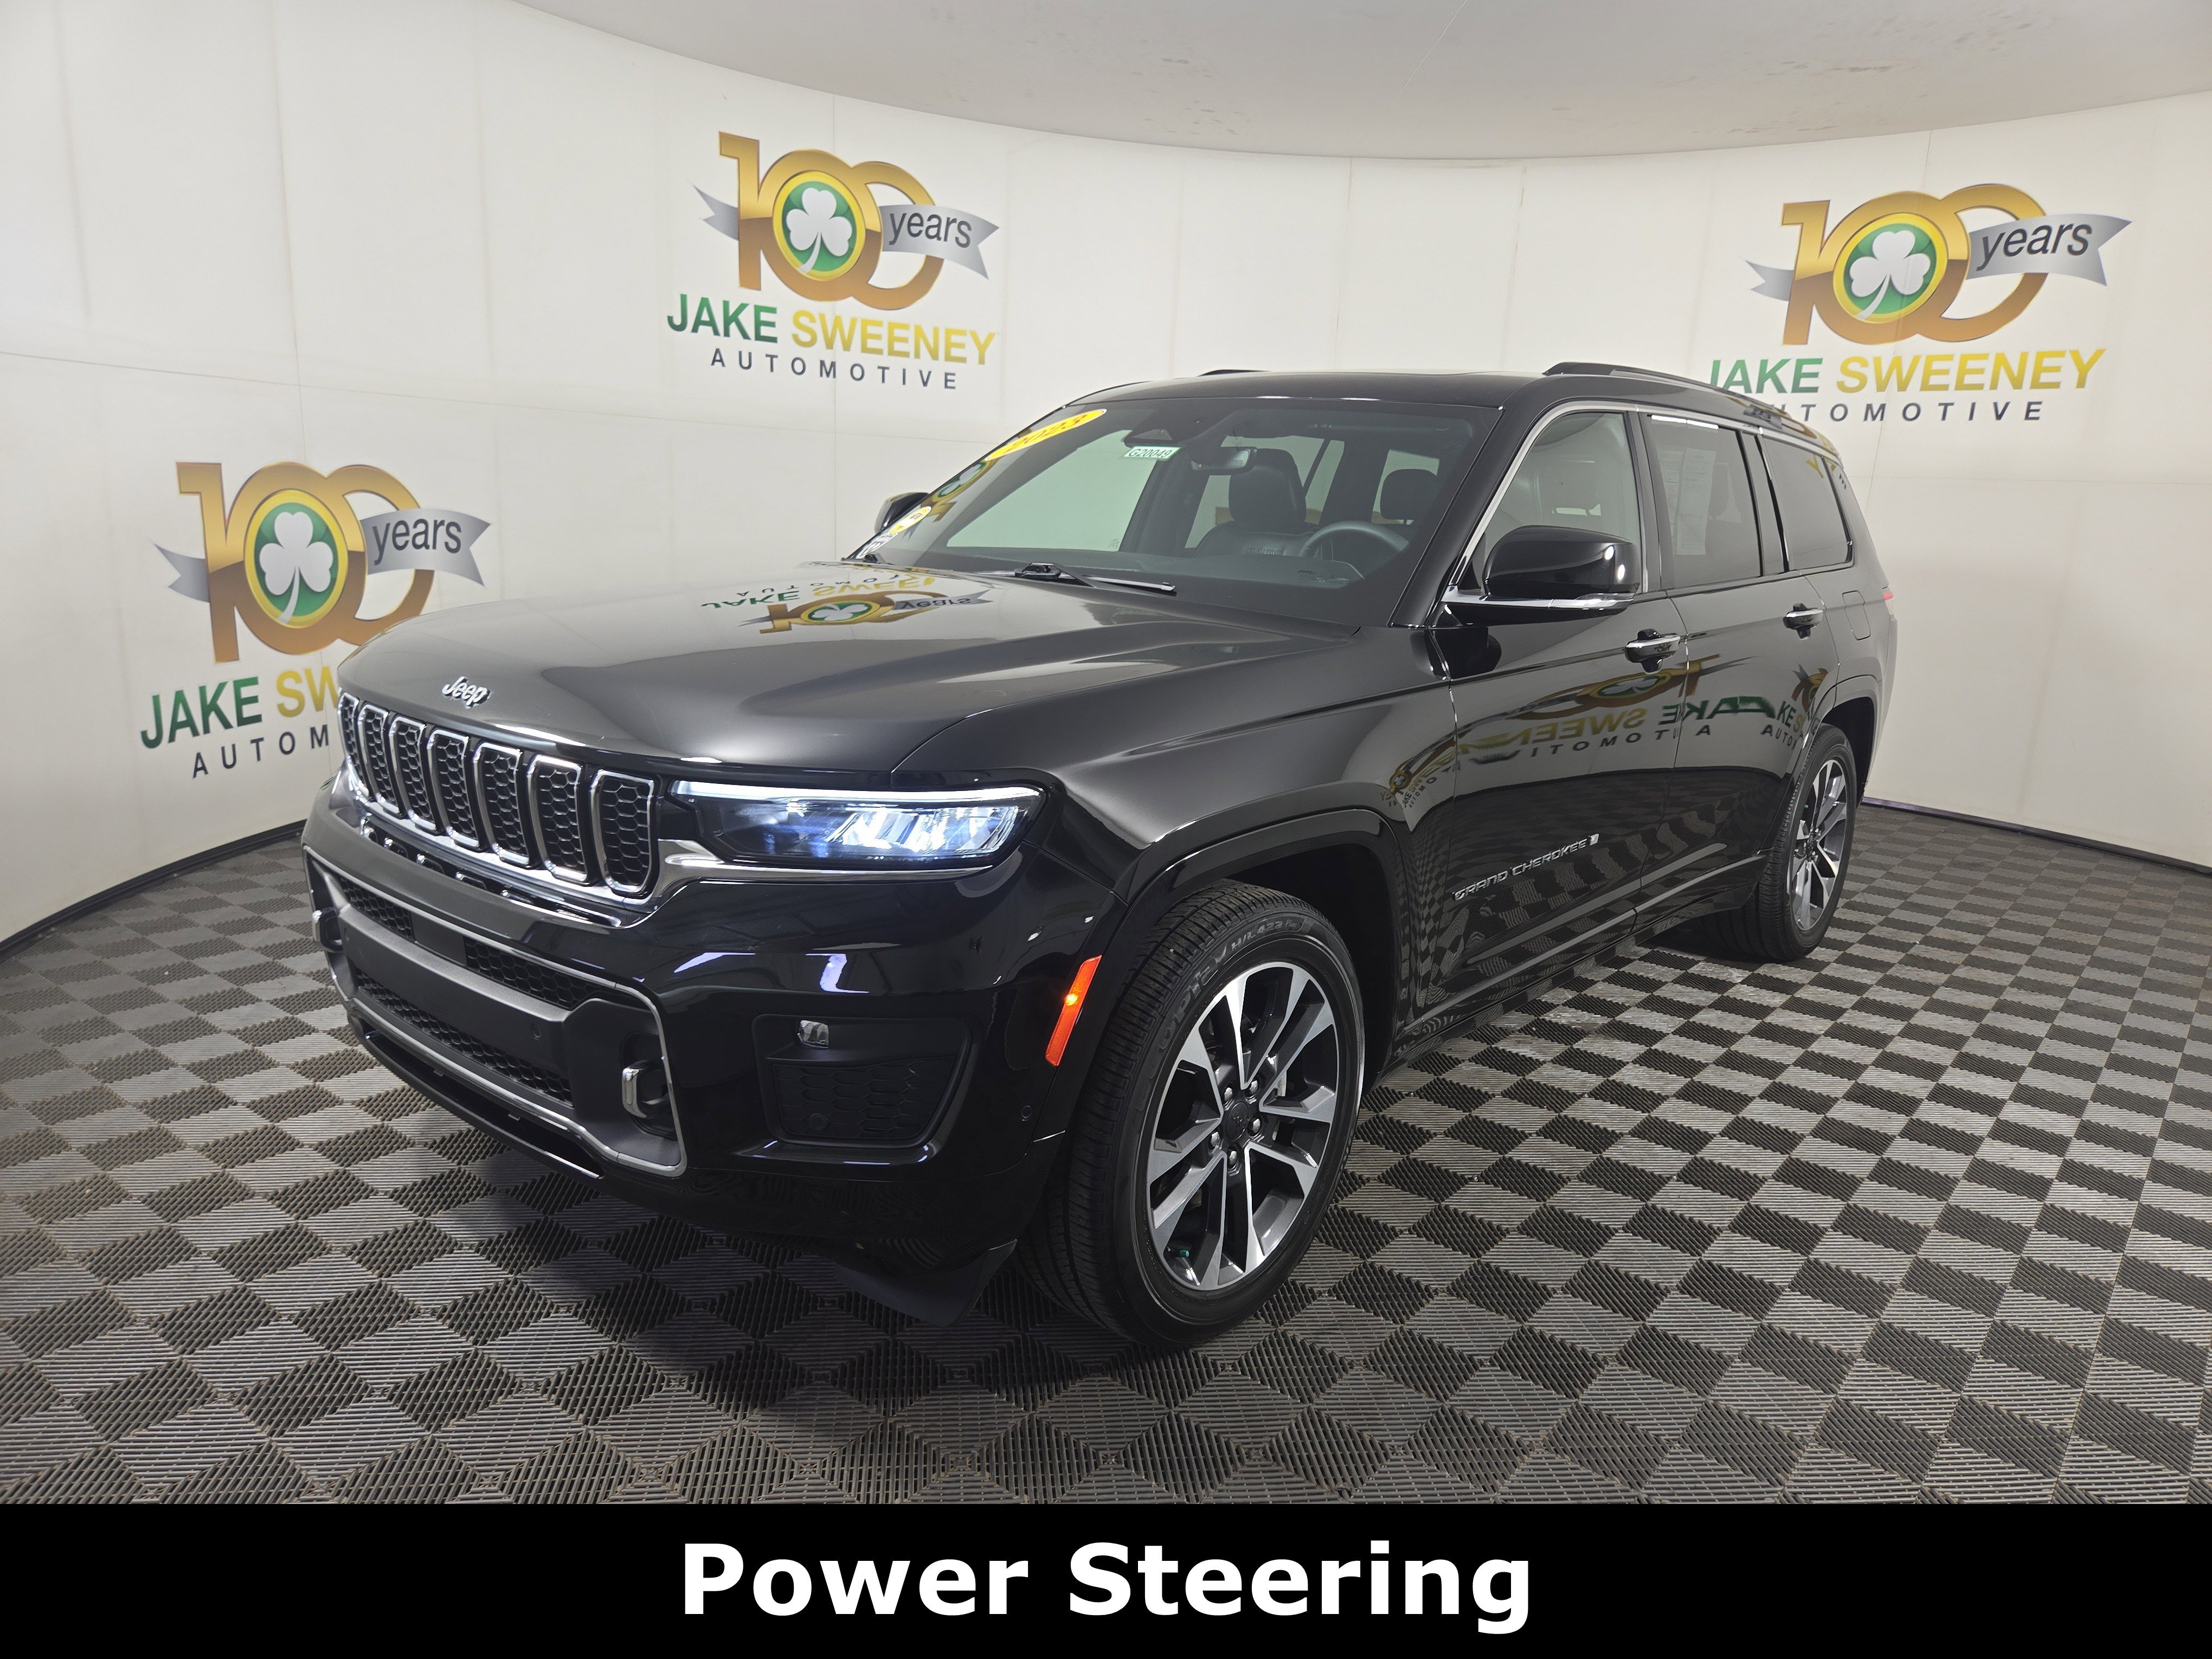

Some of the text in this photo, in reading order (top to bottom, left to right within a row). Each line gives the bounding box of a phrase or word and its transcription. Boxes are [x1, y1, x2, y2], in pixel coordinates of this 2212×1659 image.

[887, 211, 973, 249] years
[1976, 222, 2093, 272] years
[667, 293, 996, 365] JAKE SWEENEY
[710, 348, 957, 390] AUTOMOTIVE
[1836, 348, 2107, 394] SWEENEY
[1128, 448, 1173, 458] G20049
[372, 517, 462, 566] years
[140, 676, 263, 749] JAKE
[441, 676, 490, 707] Jeep
[1453, 870, 1508, 902] GRAND
[1512, 838, 1588, 877] CHEROKEE
